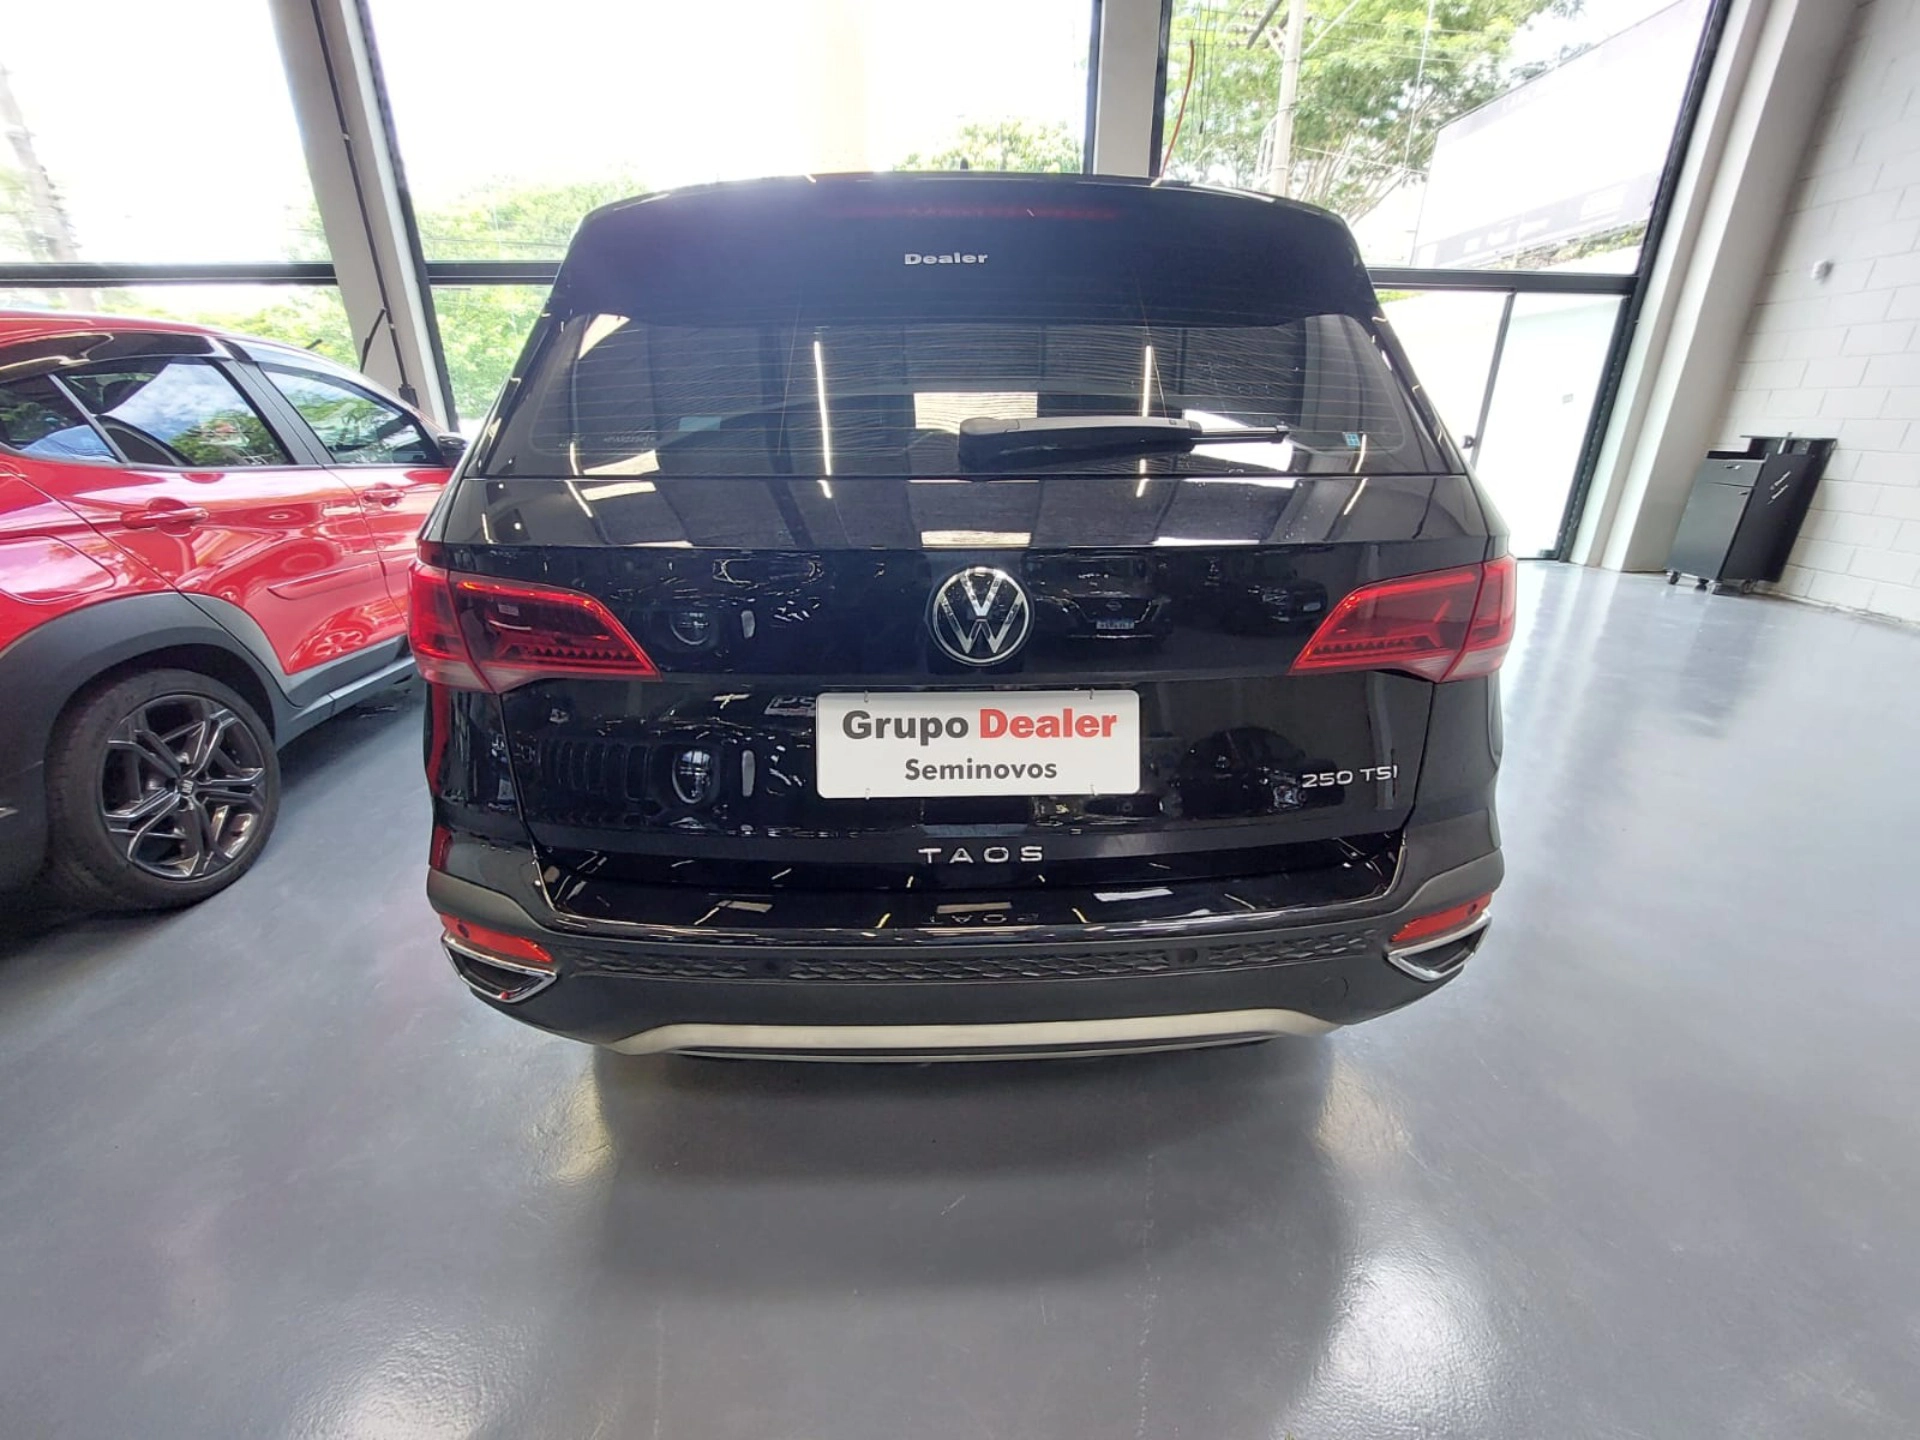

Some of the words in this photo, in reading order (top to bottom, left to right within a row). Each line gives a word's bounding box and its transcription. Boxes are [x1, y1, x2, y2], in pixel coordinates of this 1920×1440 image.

[904, 252, 988, 265] Dealer
[842, 709, 969, 746] Grupo
[979, 708, 1117, 739] Dealer
[904, 758, 1057, 781] Seminovos
[1301, 769, 1354, 788] 250
[1359, 765, 1398, 782] TSI
[917, 845, 1043, 864] TAOS
